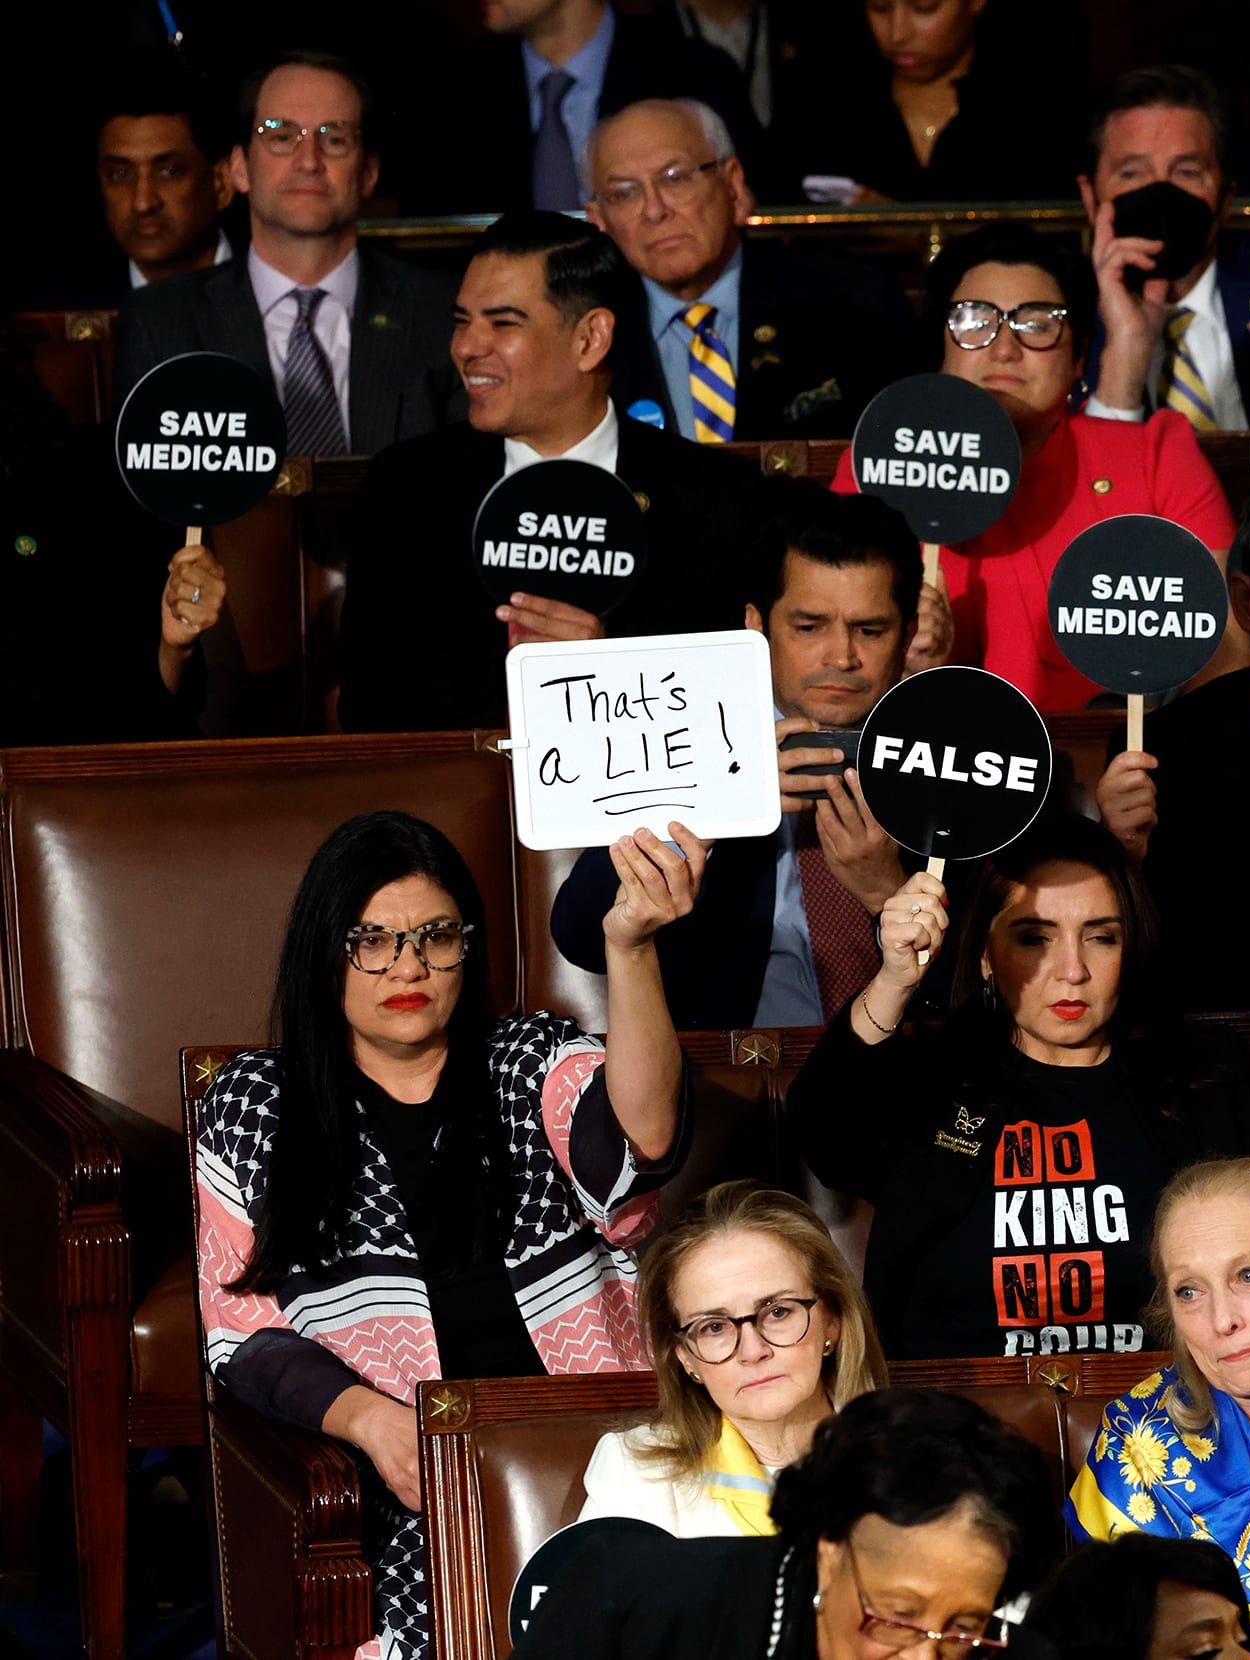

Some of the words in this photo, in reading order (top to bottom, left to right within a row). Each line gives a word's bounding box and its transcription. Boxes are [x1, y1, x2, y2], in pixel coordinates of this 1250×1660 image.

[160, 411, 247, 437] SAVE
[126, 443, 277, 472] MEDICAID
[894, 427, 981, 459] SAVE
[862, 457, 1010, 494] MEDICAID
[517, 512, 607, 542] SAVE
[482, 540, 635, 577] MEDICAID
[1091, 573, 1184, 603] SAVE
[1057, 606, 1217, 639] MEDICAID
[540, 672, 688, 723] That's
[538, 747, 581, 786] a
[871, 735, 1039, 793] FALSE
[1002, 1126, 1083, 1179] NO
[994, 1184, 1130, 1248] KING
[1001, 1258, 1093, 1320] NO
